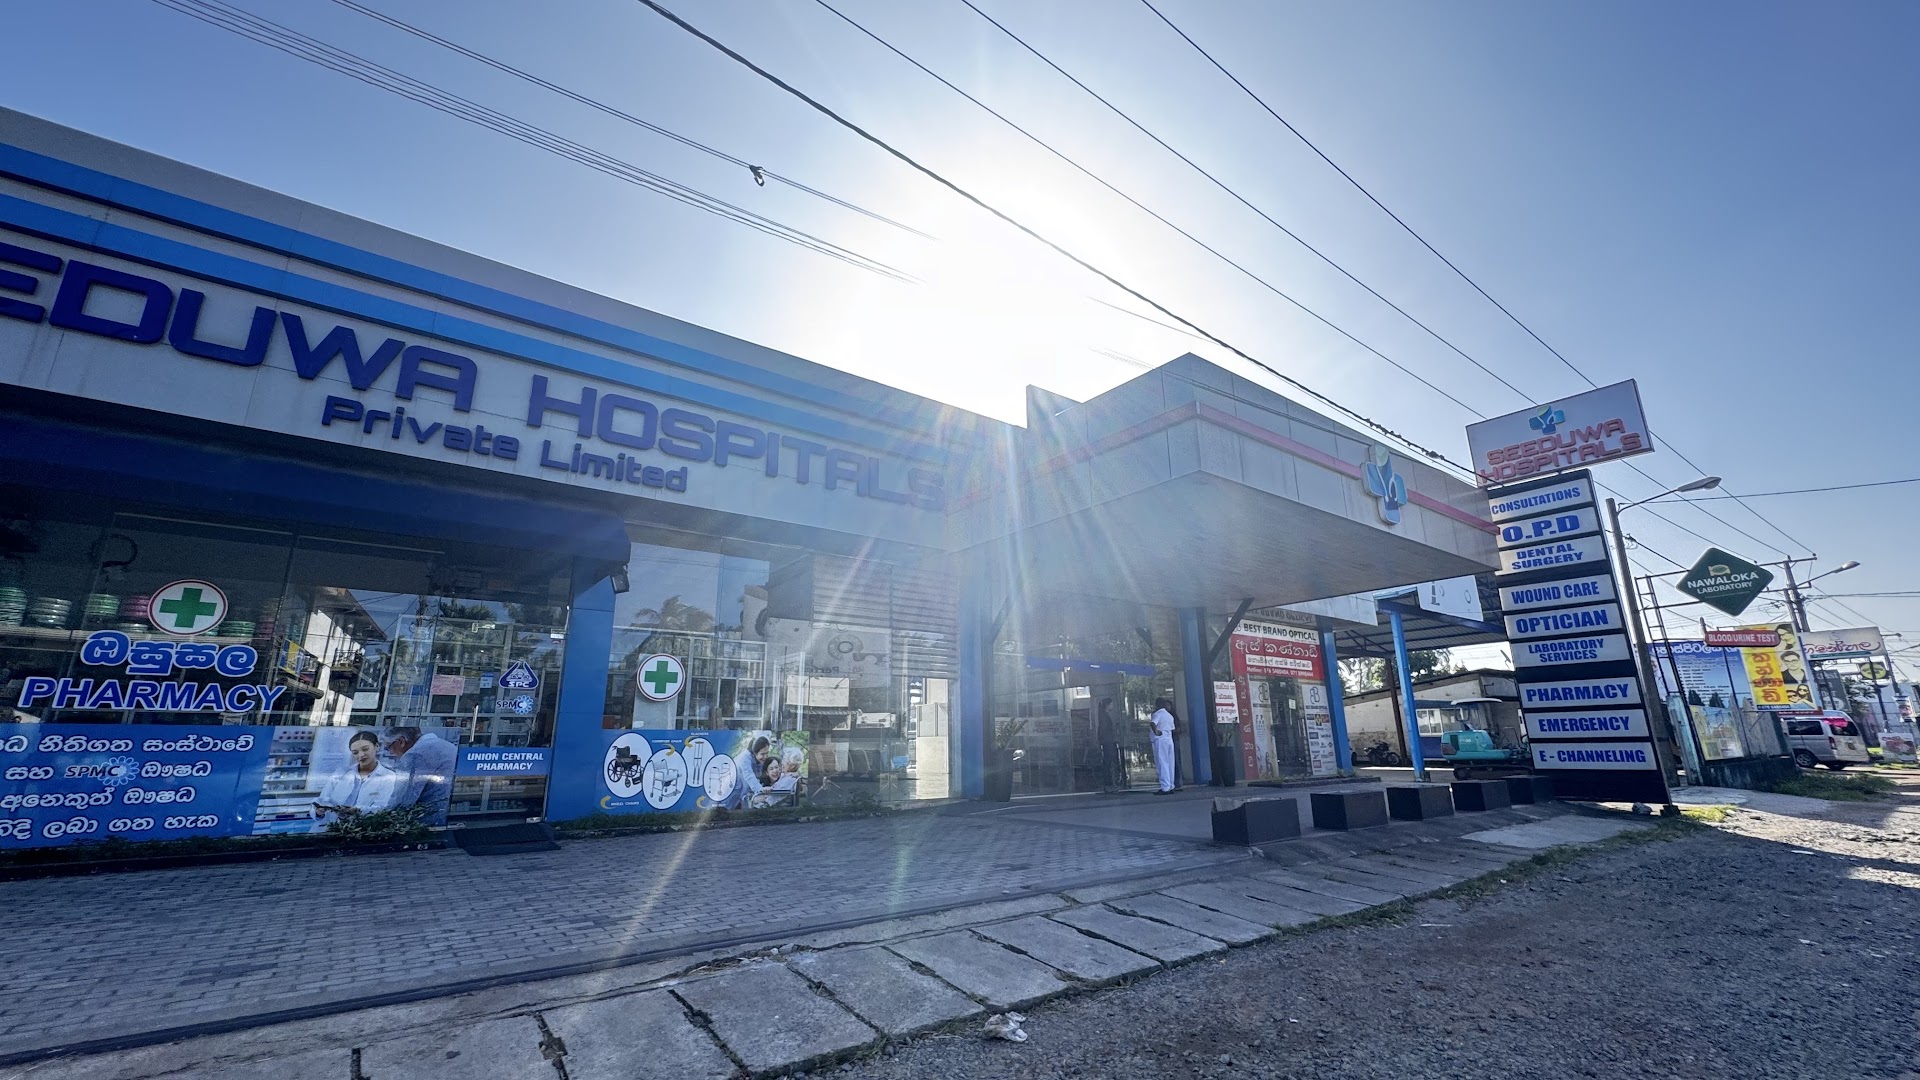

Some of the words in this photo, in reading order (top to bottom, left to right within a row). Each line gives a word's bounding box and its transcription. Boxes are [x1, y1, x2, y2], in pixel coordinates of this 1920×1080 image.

[322, 395, 519, 461] Private
[540, 440, 688, 493] Limited
[527, 374, 946, 511] HOSPITALS
[1486, 418, 1626, 467] SEEDUWA
[1479, 432, 1643, 484] HOSPITALS
[1491, 487, 1581, 515] CONSULTATIONS
[1502, 514, 1580, 543] O.P.D
[1511, 551, 1584, 570] SURGERY
[1516, 543, 1576, 560] DENTAL
[1687, 570, 1760, 589] NAWALOKA
[1697, 581, 1753, 595] LABORATORY
[1511, 586, 1561, 604] WOUND
[1563, 581, 1600, 599] CARE
[1515, 609, 1609, 634] OPTICIAN
[1243, 623, 1262, 634] BEST
[1263, 625, 1288, 637] BRAND
[1288, 629, 1317, 641] OPTICAL
[1756, 633, 1776, 643] TEST
[1528, 638, 1604, 654] LABORATORY
[1539, 650, 1598, 663] SERVICES
[508, 680, 530, 688] SPC
[1526, 683, 1629, 702] PHARMACY
[18, 676, 287, 713] PHARMACY
[496, 700, 524, 709] SPMC
[1538, 716, 1630, 732] EMERGENCY
[467, 752, 500, 761] UNION
[501, 752, 544, 761] CENTRAL
[1539, 750, 1547, 762] E
[1557, 749, 1647, 763] CHANNELING
[5, 765, 54, 780] සහ
[65, 765, 120, 778] SPMC
[476, 763, 533, 771] PHARMACY
[43, 817, 98, 838] ලබා
